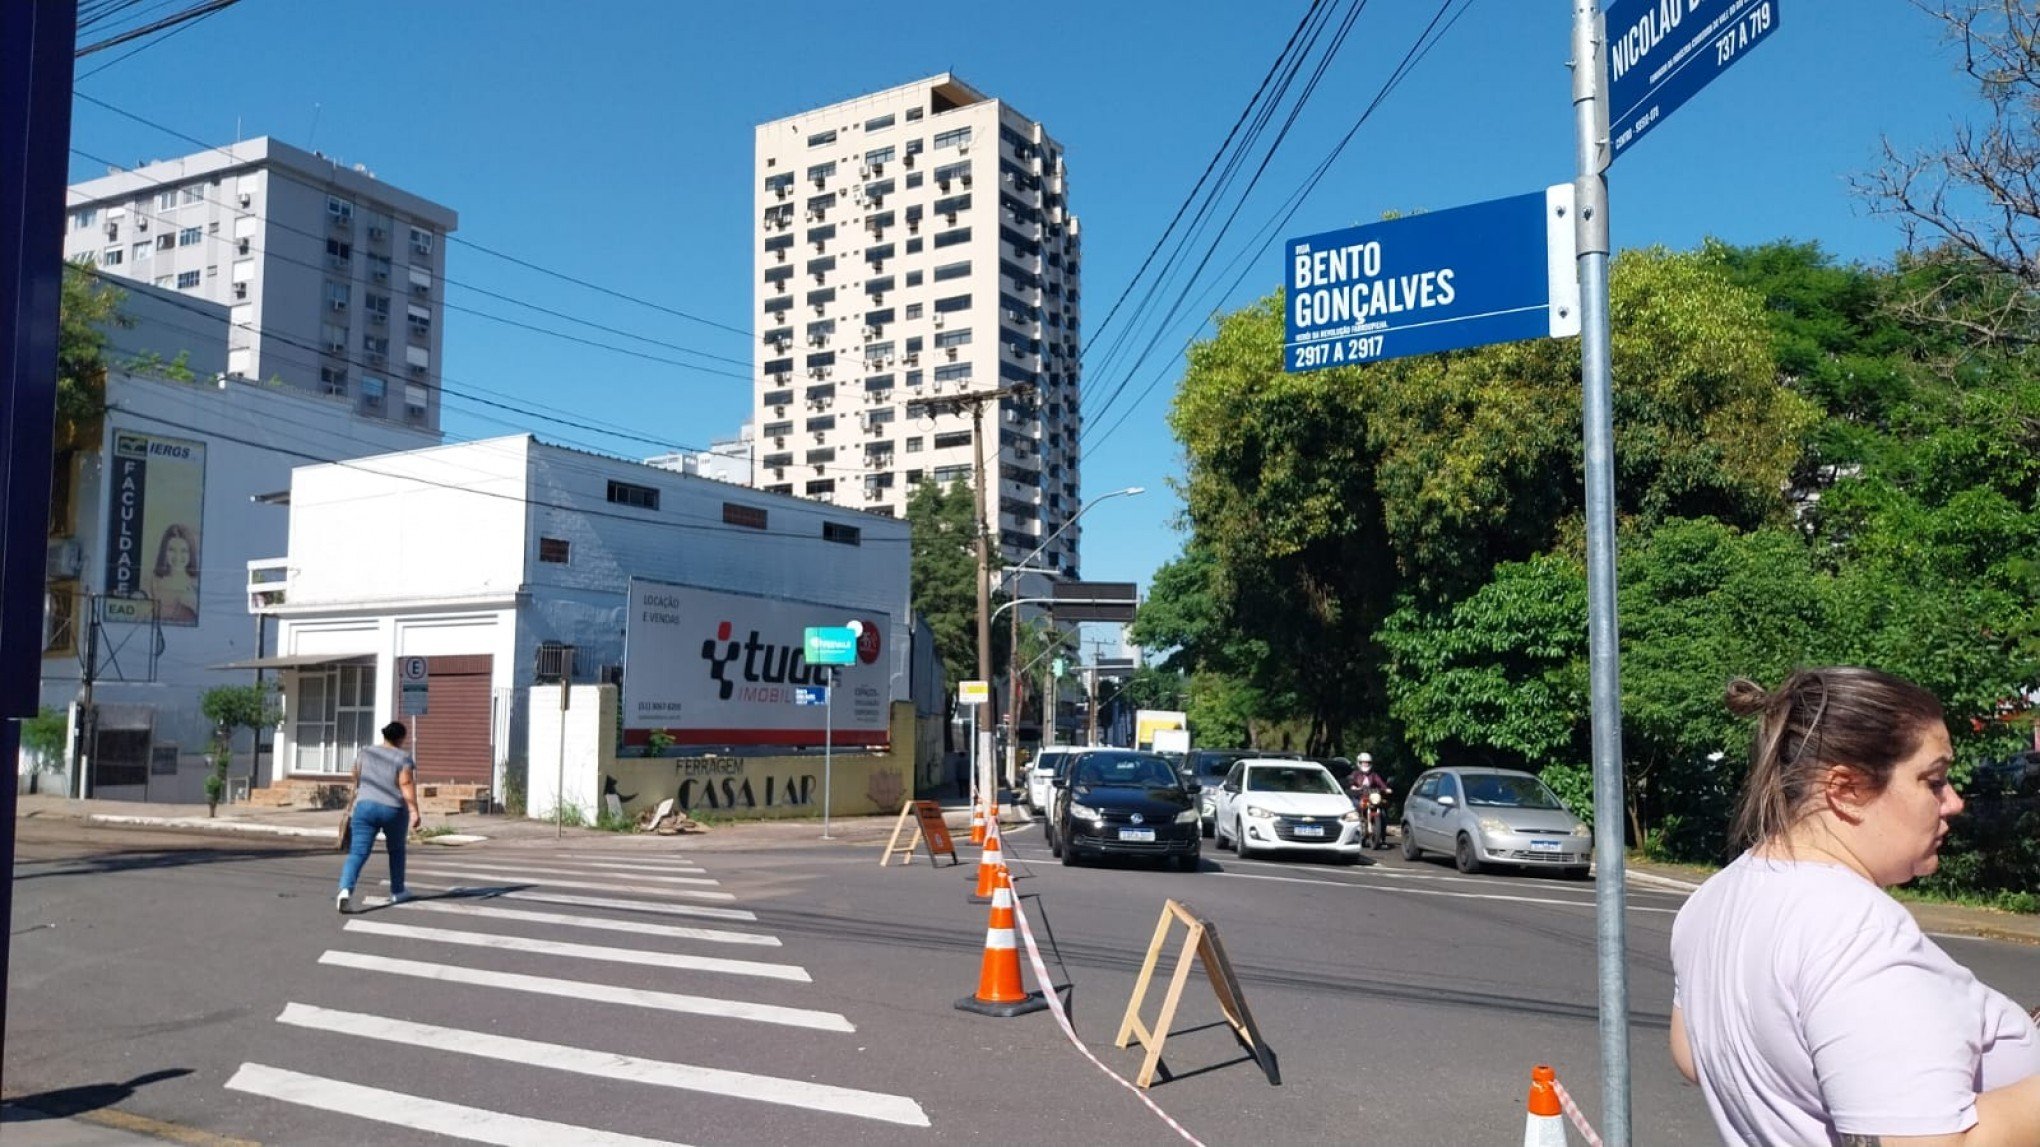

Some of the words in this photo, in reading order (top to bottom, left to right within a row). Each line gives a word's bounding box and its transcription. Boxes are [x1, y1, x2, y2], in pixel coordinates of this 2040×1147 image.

[1715, 29, 1736, 66] 737
[1738, 21, 1748, 49] A
[1749, 2, 1771, 40] 719
[1295, 241, 1381, 289] BENTO
[1295, 269, 1455, 328] GONÇALVES
[1295, 343, 1330, 368] 2917
[1333, 341, 1344, 362] A
[1348, 335, 1384, 360] 2917
[117, 461, 137, 597] FACULDADE
[109, 604, 135, 615] EAD
[676, 757, 744, 775] FERRAGEM
[678, 775, 756, 809] CASA
